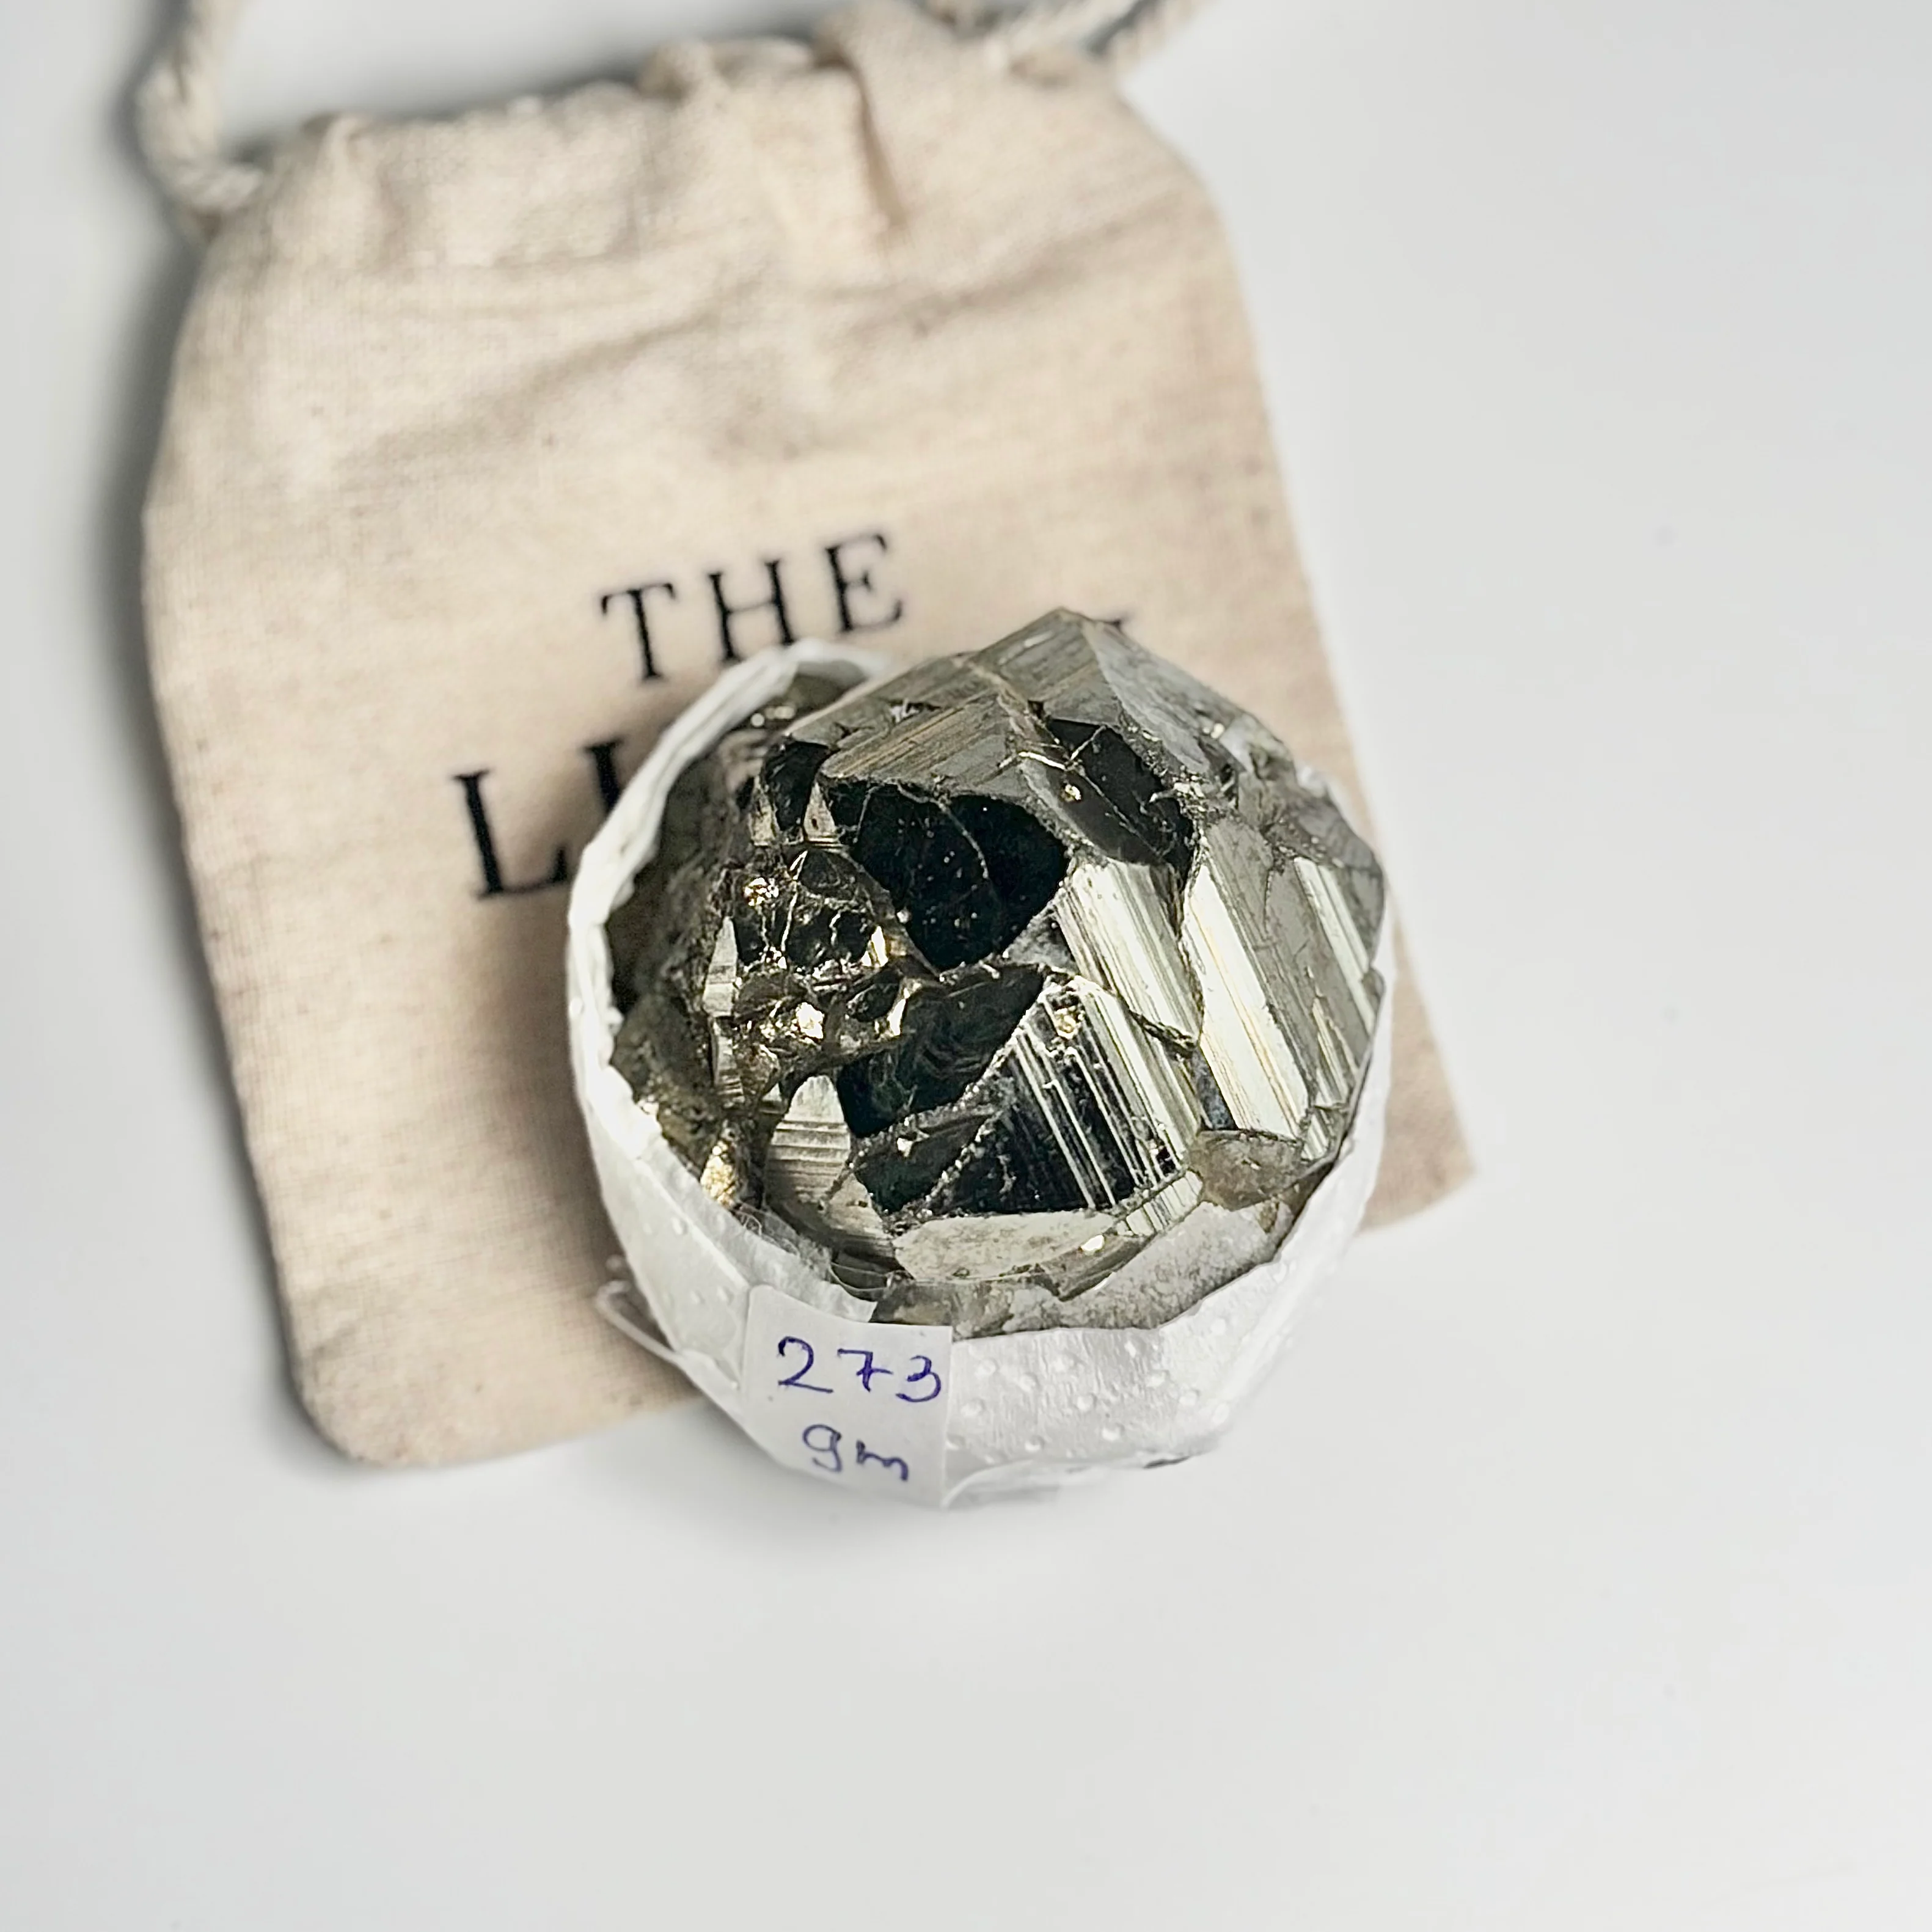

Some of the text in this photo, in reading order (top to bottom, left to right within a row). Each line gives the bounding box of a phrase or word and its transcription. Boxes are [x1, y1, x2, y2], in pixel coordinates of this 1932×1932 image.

[599, 532, 904, 685] THE
[777, 1335, 942, 1403] 273
[801, 1423, 910, 1484] gm
